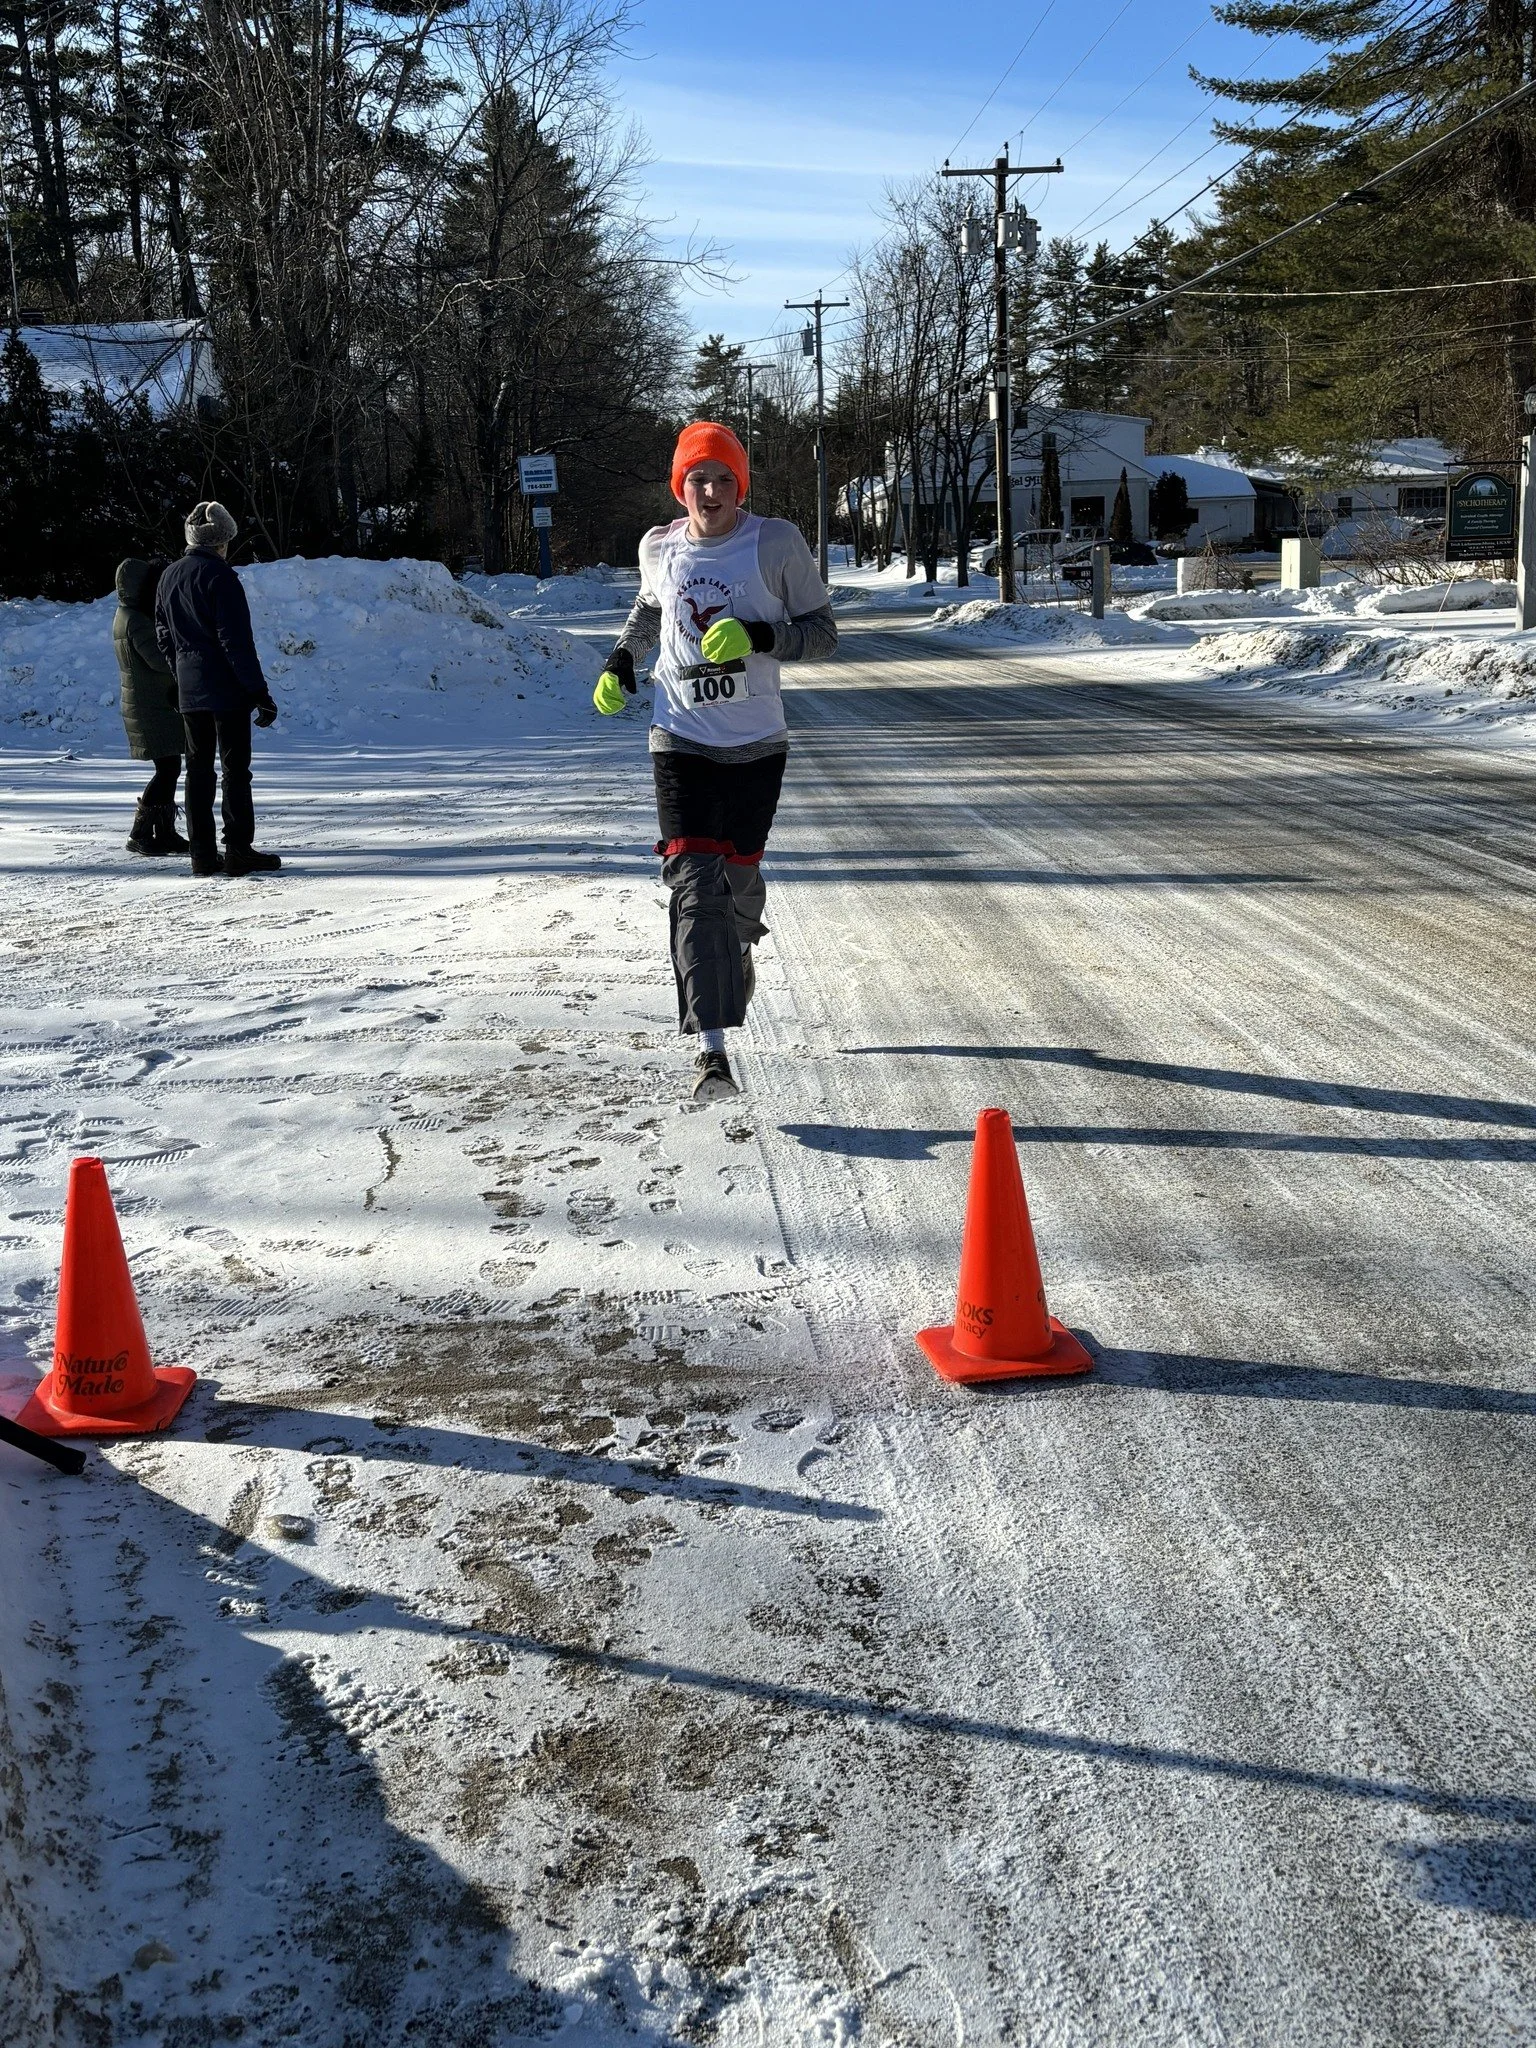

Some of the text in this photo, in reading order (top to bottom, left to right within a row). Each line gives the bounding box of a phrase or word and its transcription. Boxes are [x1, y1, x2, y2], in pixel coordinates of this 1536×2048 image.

[1456, 498, 1507, 508] PSYCHOTHERAPY
[677, 577, 731, 597] KEZAR LAKE
[692, 675, 735, 703] 100
[56, 1350, 129, 1375] Nature
[56, 1375, 124, 1398] Made
